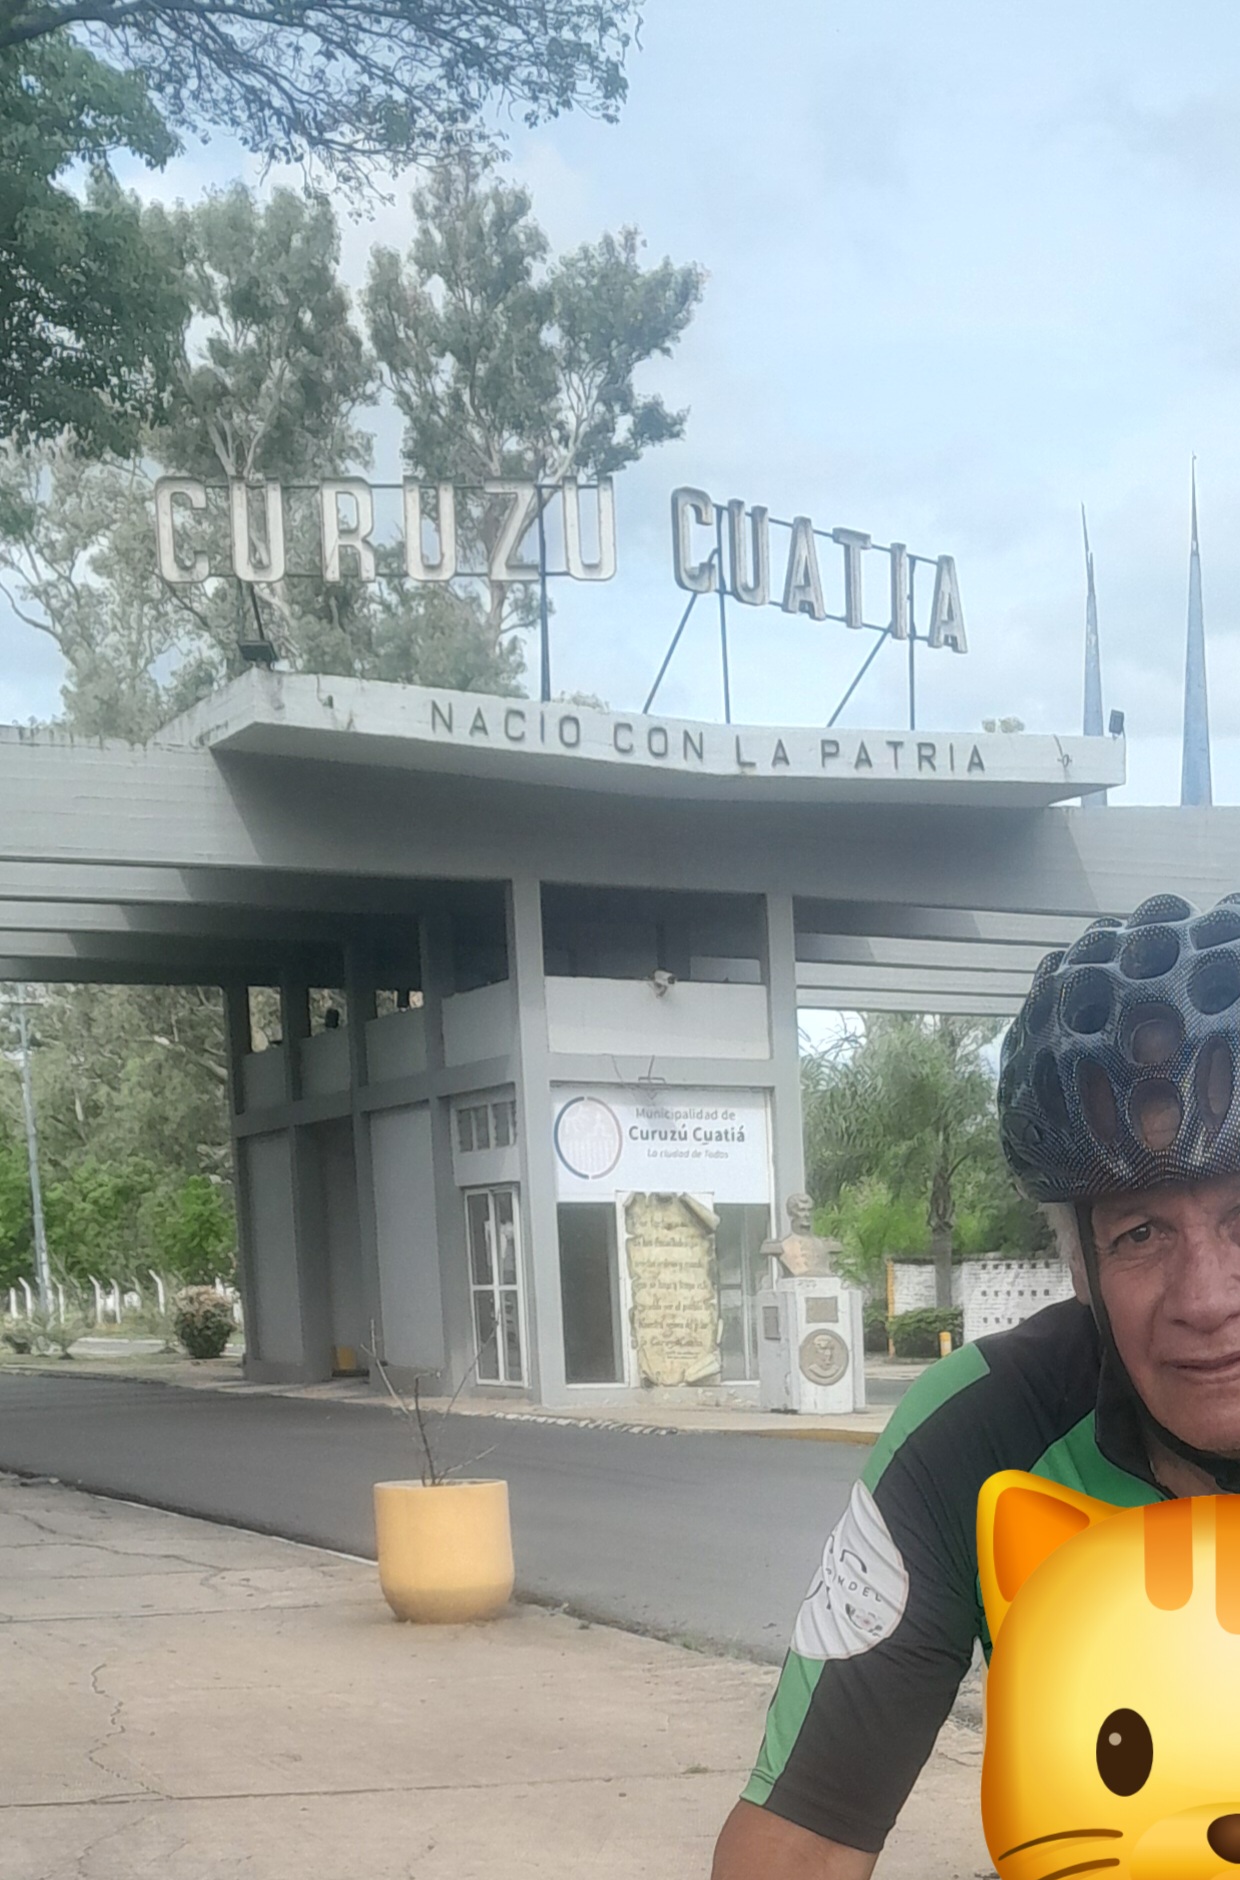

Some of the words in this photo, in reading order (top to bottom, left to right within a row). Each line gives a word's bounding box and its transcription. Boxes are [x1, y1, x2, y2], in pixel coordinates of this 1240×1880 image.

[154, 476, 616, 584] CURUZU
[671, 486, 968, 654] CUATIA
[429, 699, 580, 750] NACIO
[612, 721, 705, 761] CON
[734, 734, 790, 770] LA
[820, 738, 987, 773] PATRIA
[628, 1123, 688, 1141] Curuzú
[692, 1124, 745, 1143] Cuatiá
[635, 1107, 718, 1121] Municipalidad
[721, 1109, 736, 1120] de
